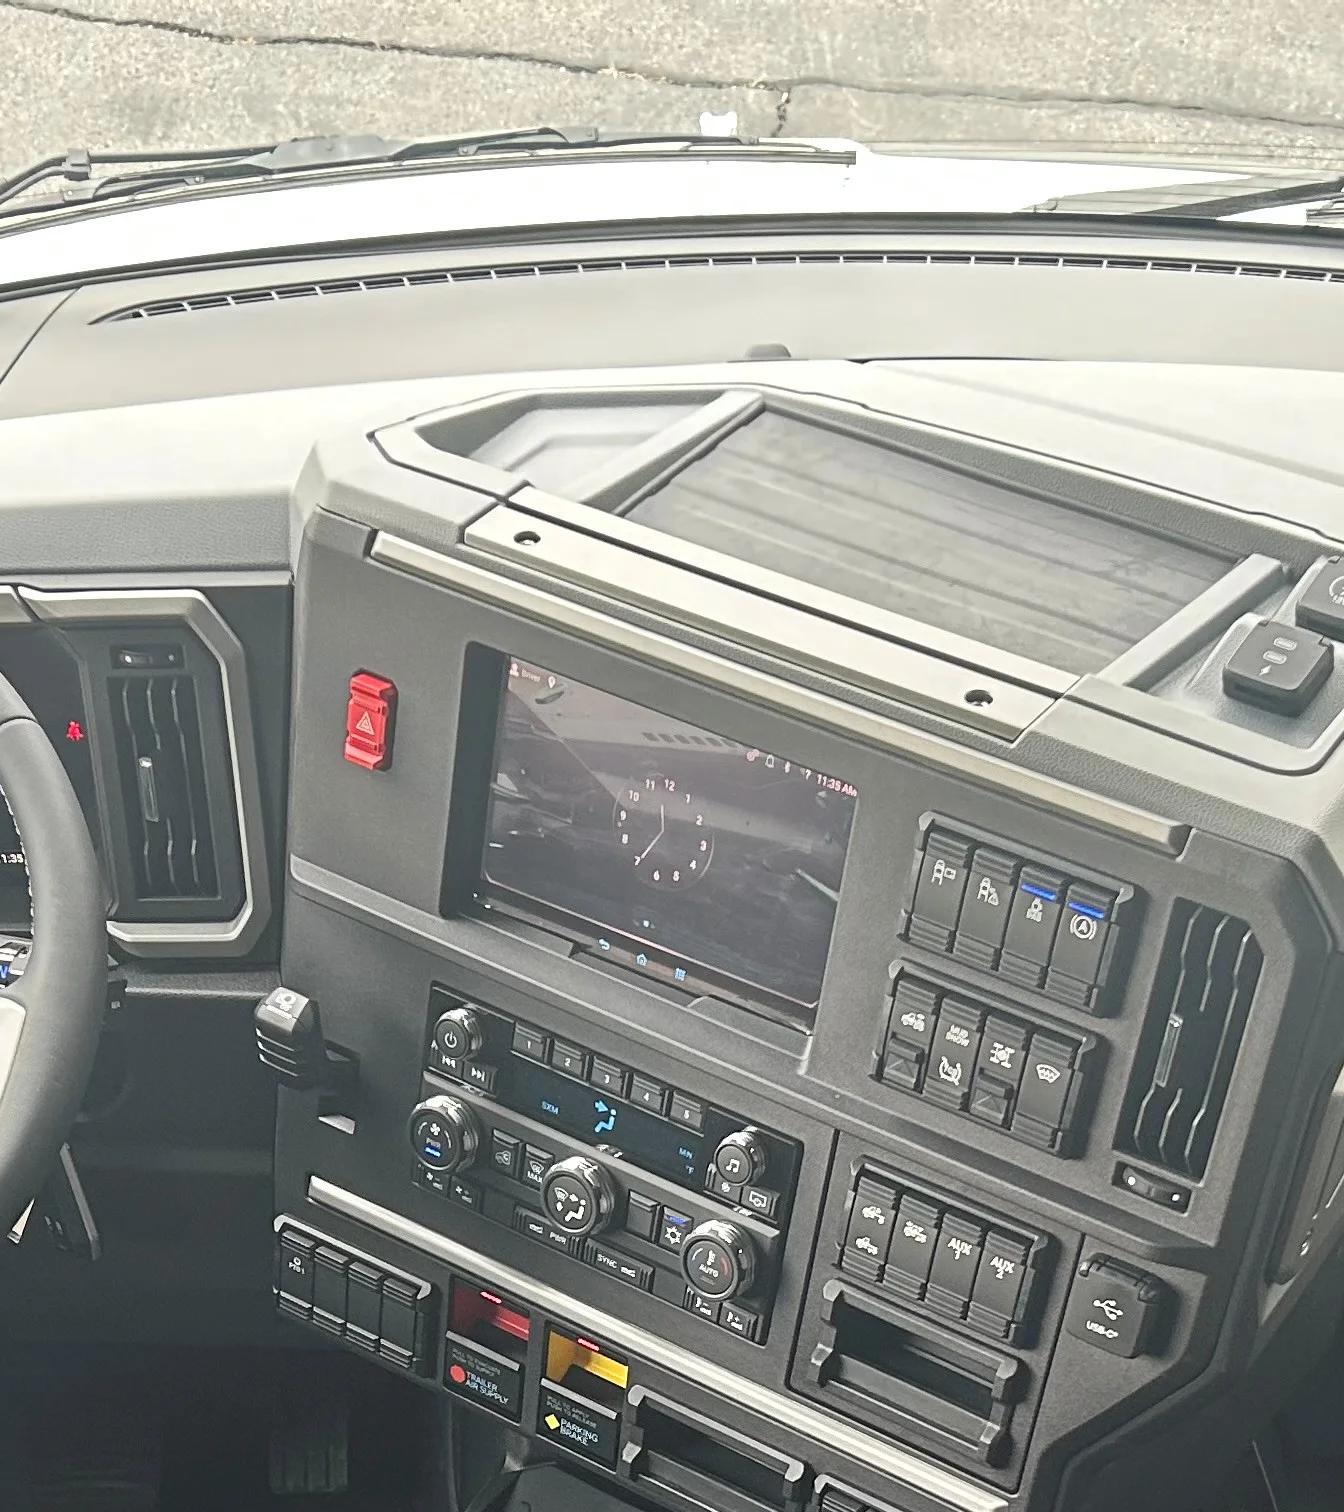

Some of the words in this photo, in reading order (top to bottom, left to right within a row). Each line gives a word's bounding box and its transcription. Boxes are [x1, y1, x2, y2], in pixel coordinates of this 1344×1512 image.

[645, 778, 656, 791] 11
[665, 778, 676, 792] 12
[817, 774, 841, 792] 11:35
[841, 784, 858, 797] AM
[628, 789, 640, 802] 10
[685, 793, 691, 804] 1
[620, 810, 627, 820] 9
[696, 814, 703, 826] 2
[700, 840, 707, 852] 3
[634, 855, 641, 866] 7
[689, 859, 696, 870] 4
[653, 870, 660, 881] 6
[564, 1057, 571, 1068] 2
[604, 1074, 611, 1084] 3
[643, 1092, 649, 1102] 4
[541, 1100, 559, 1115] SXM
[683, 1109, 690, 1120] 5
[526, 1170, 543, 1183] MAX
[947, 1237, 973, 1256] AUX
[597, 1253, 618, 1269] SYNC
[989, 1256, 1015, 1274] AUX
[698, 1263, 719, 1278] AUTO
[995, 1268, 1004, 1280] 2
[466, 1371, 498, 1392] TRAILER
[465, 1380, 478, 1391] AIR
[479, 1385, 509, 1404] SUPPLY
[560, 1418, 599, 1443] PARKING
[560, 1427, 589, 1446] BRAKE
